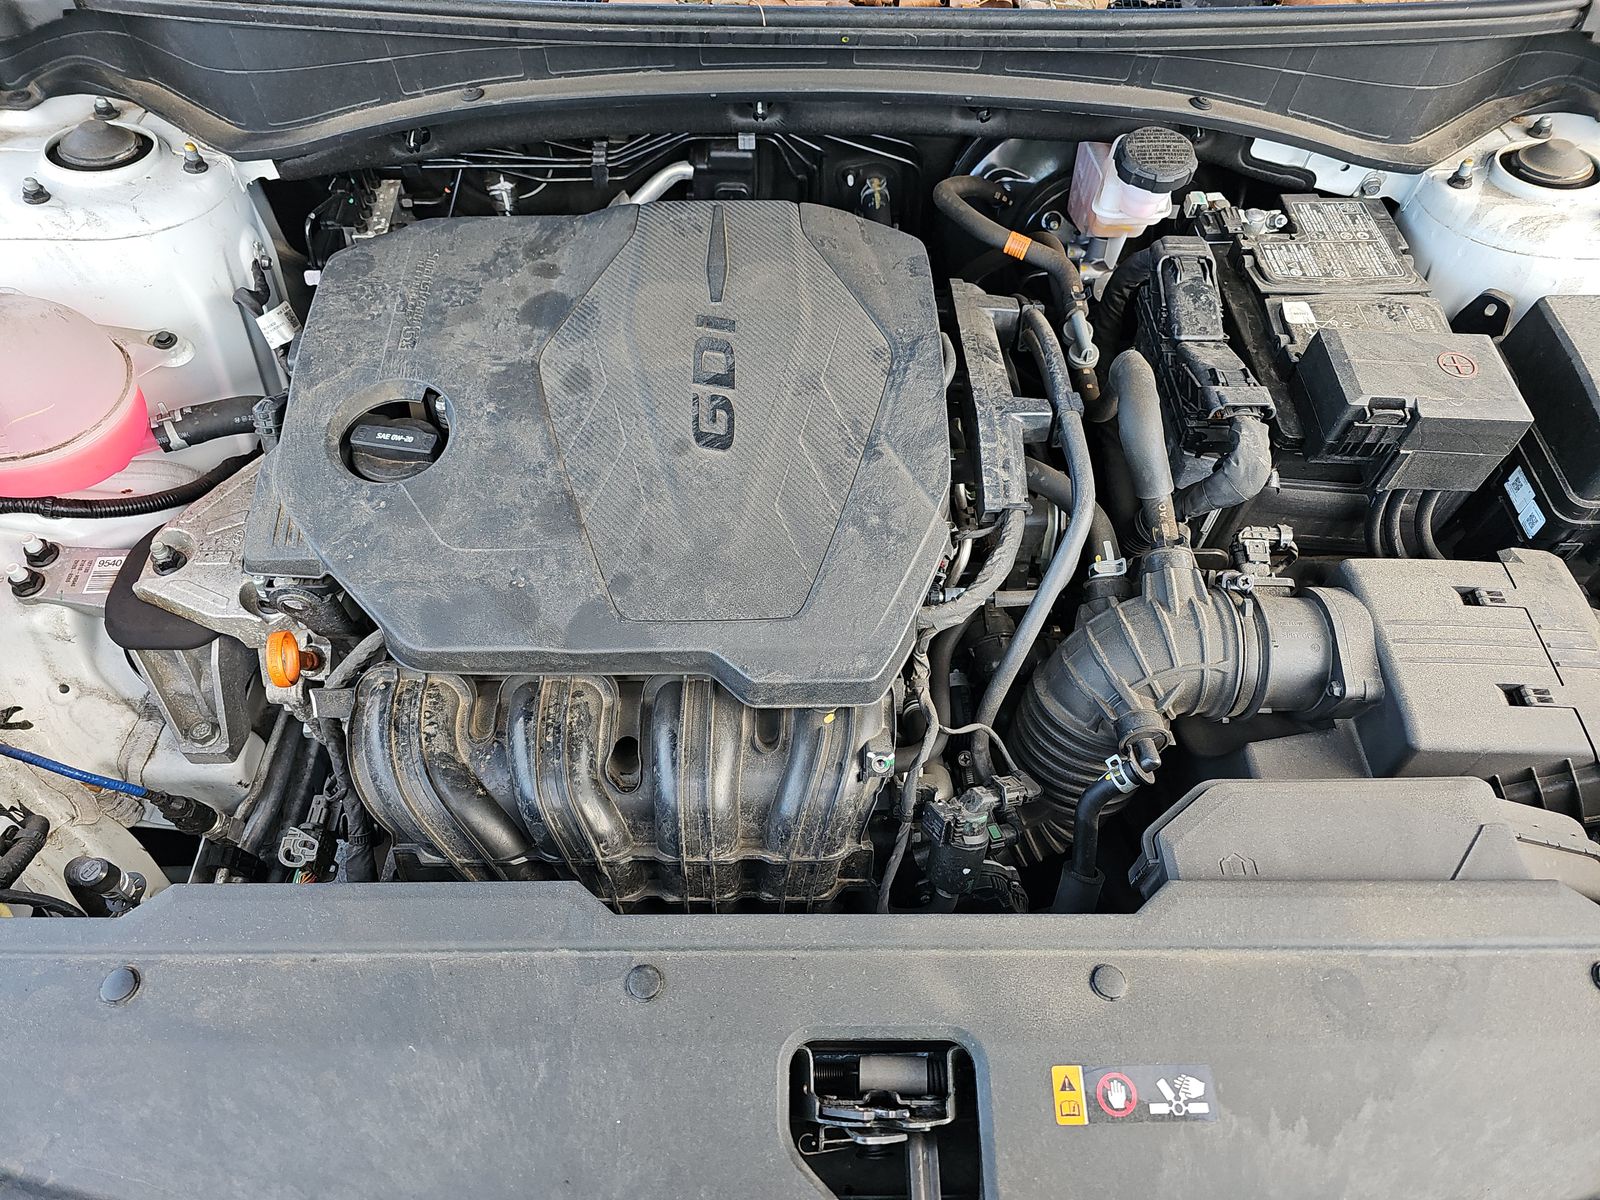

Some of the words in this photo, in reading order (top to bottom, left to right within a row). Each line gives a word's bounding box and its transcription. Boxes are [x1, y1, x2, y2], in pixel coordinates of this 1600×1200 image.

[692, 315, 735, 450] GDI
[375, 432, 391, 440] SAE
[98, 559, 123, 568] 9540
